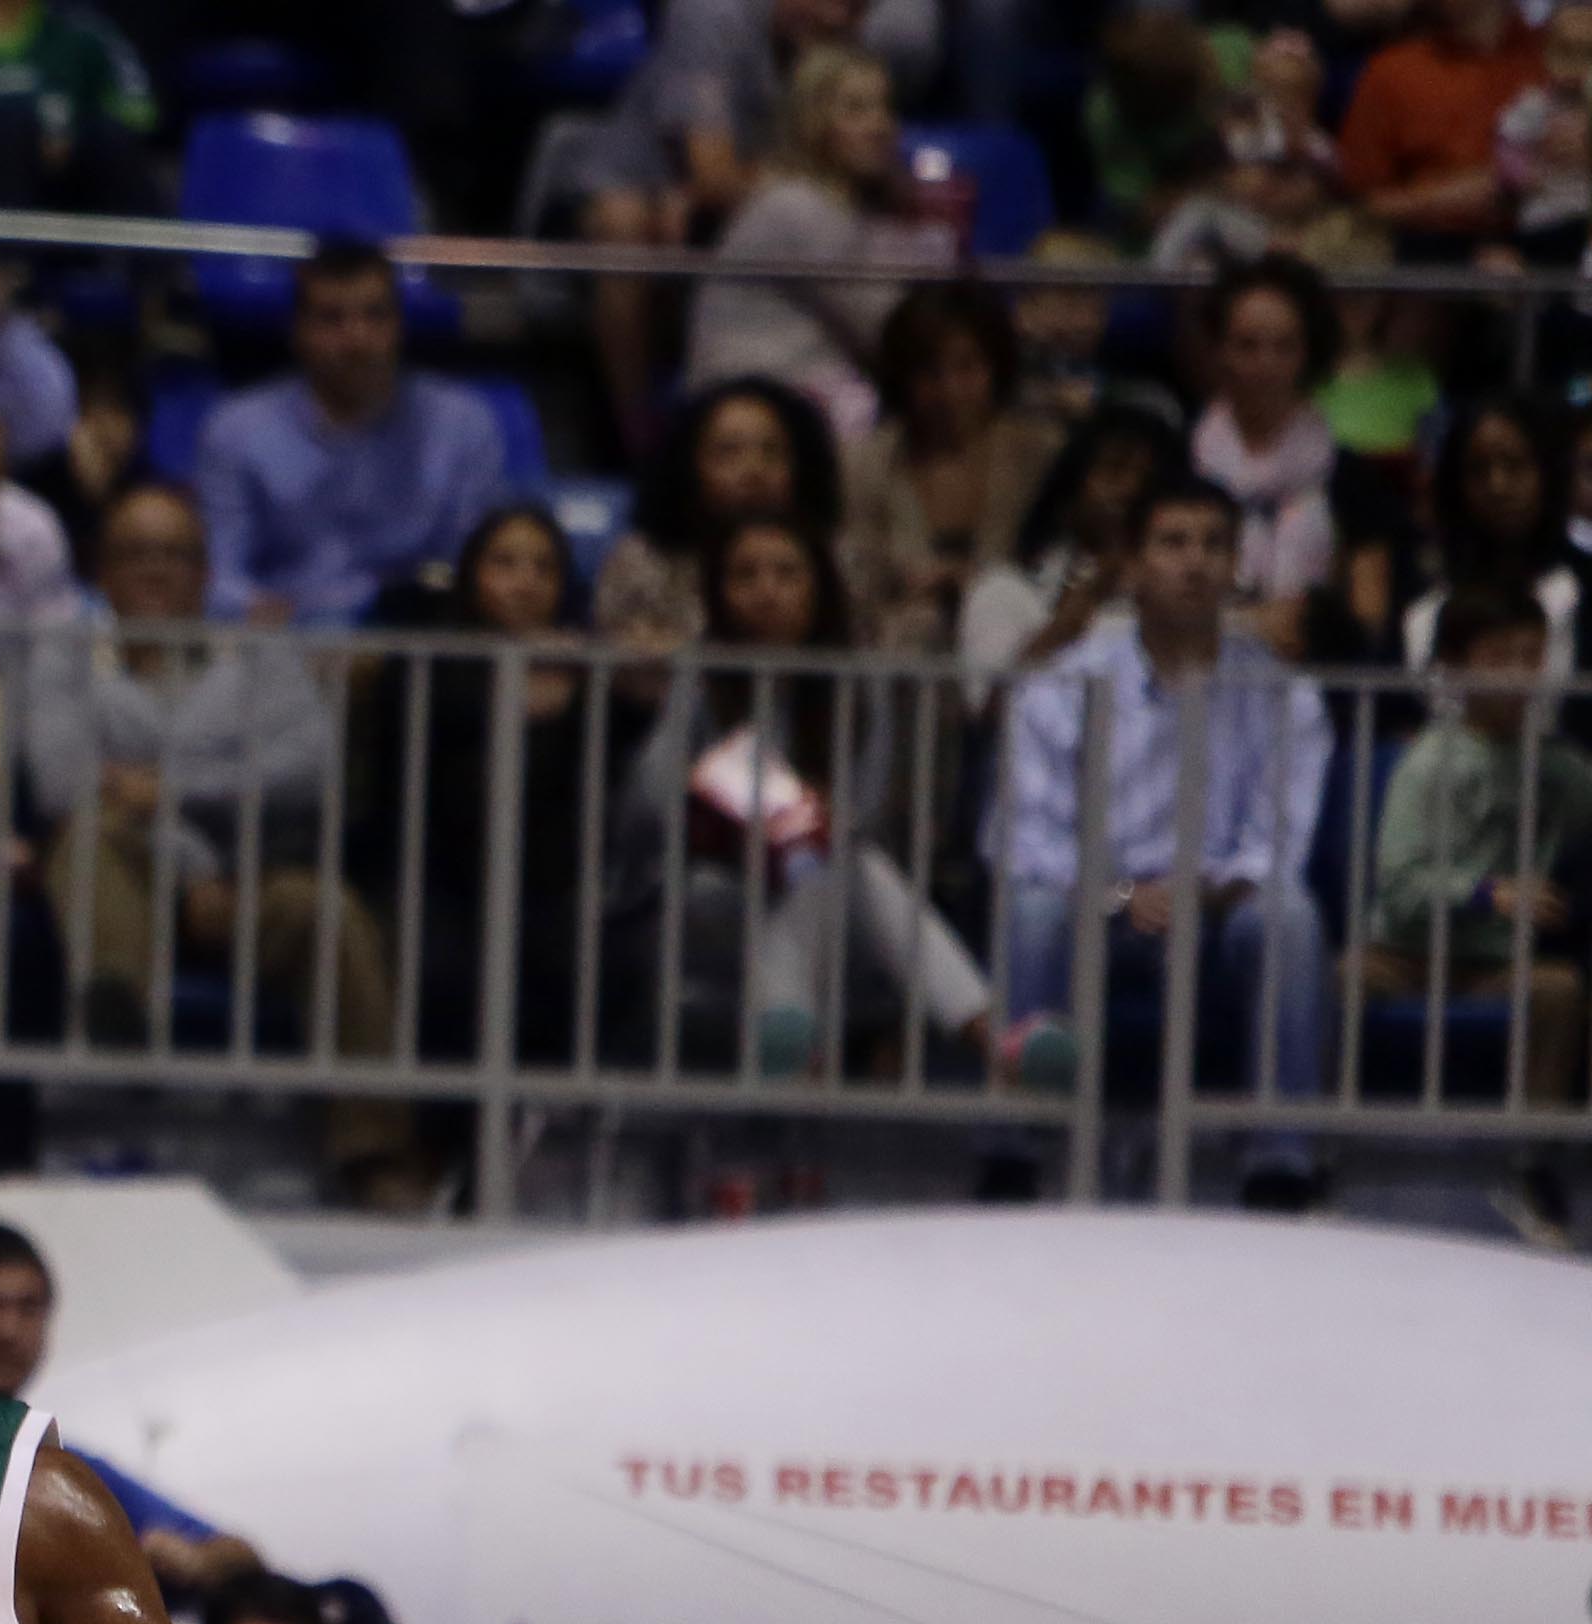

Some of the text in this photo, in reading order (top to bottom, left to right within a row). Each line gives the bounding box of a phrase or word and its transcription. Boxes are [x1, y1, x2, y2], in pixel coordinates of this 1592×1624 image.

[620, 1460, 1592, 1541] TUS RESTAURANTES EN MUE
